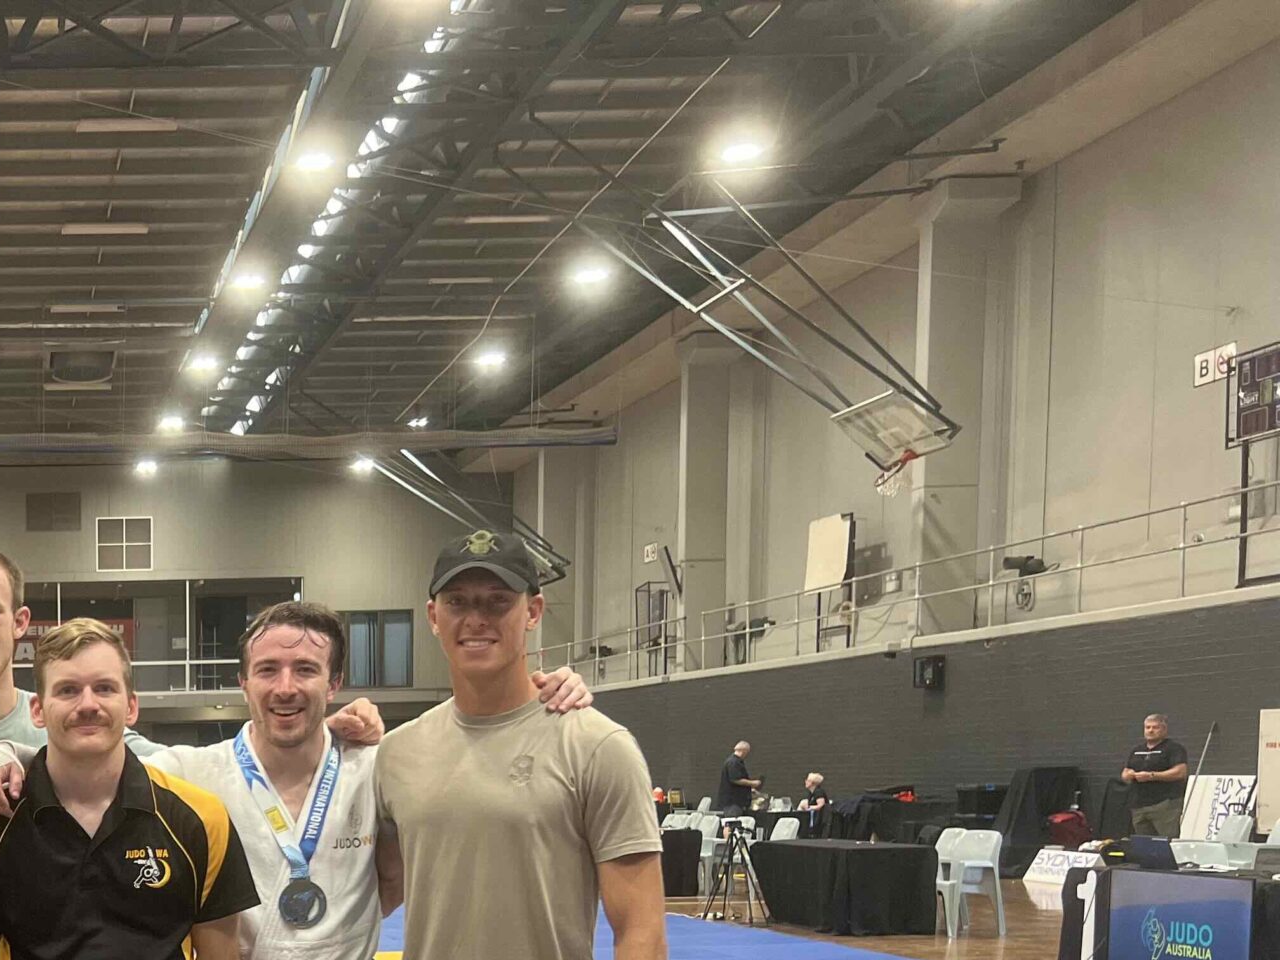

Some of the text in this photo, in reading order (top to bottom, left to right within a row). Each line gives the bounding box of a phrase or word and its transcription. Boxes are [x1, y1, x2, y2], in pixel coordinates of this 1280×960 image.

[1200, 359, 1209, 378] B
[305, 769, 336, 839] INTERNATIONAL
[125, 849, 146, 859] JUDO
[1167, 921, 1213, 947] JUDO
[1165, 943, 1212, 960] AUSTRALIA
